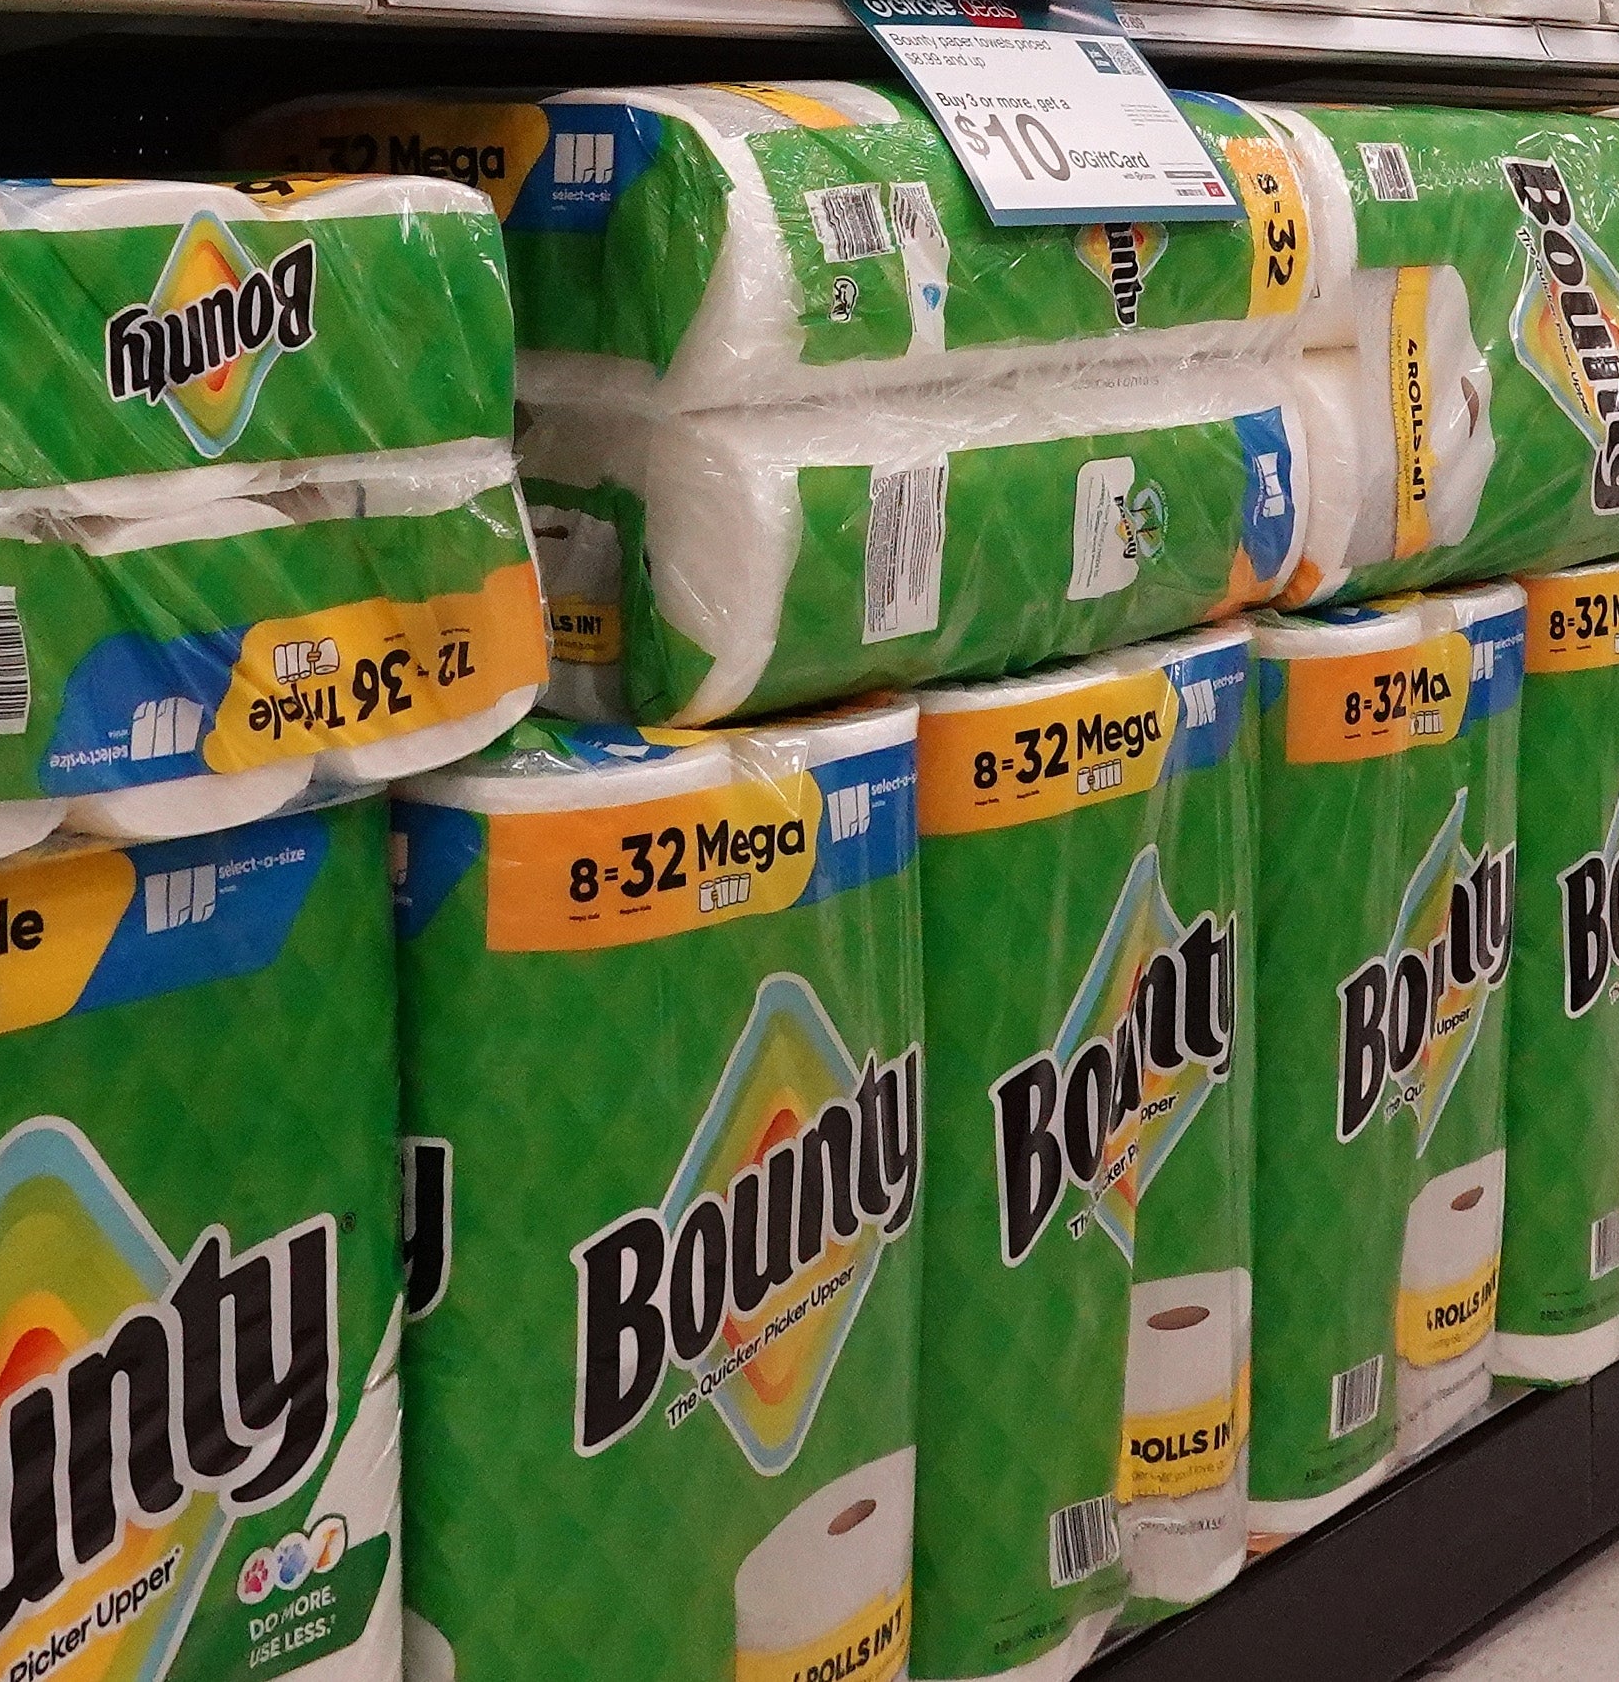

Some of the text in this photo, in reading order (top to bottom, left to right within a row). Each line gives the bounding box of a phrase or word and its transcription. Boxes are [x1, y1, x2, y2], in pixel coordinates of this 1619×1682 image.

[892, 33, 1051, 52] Bounty paper towels priced
[945, 54, 968, 67] and
[969, 57, 986, 70] up
[935, 92, 1070, 111] Buy 3 or more, get a
[389, 133, 507, 190] Mega
[953, 111, 1072, 182] $10
[1085, 150, 1149, 168] GiftCard
[106, 242, 315, 402] Bounty
[247, 680, 346, 741] Triple
[1076, 704, 1162, 760] Mega
[217, 847, 307, 880] select-a-size
[696, 817, 806, 873] Mega
[583, 1050, 920, 1449] Bounty
[1434, 1289, 1480, 1330] ROLLS
[667, 1263, 857, 1429] The Quicker Picker Upper
[8, 1556, 180, 1682] Picker Upper
[248, 1584, 337, 1642] DO MORE.
[248, 1637, 282, 1670] USE
